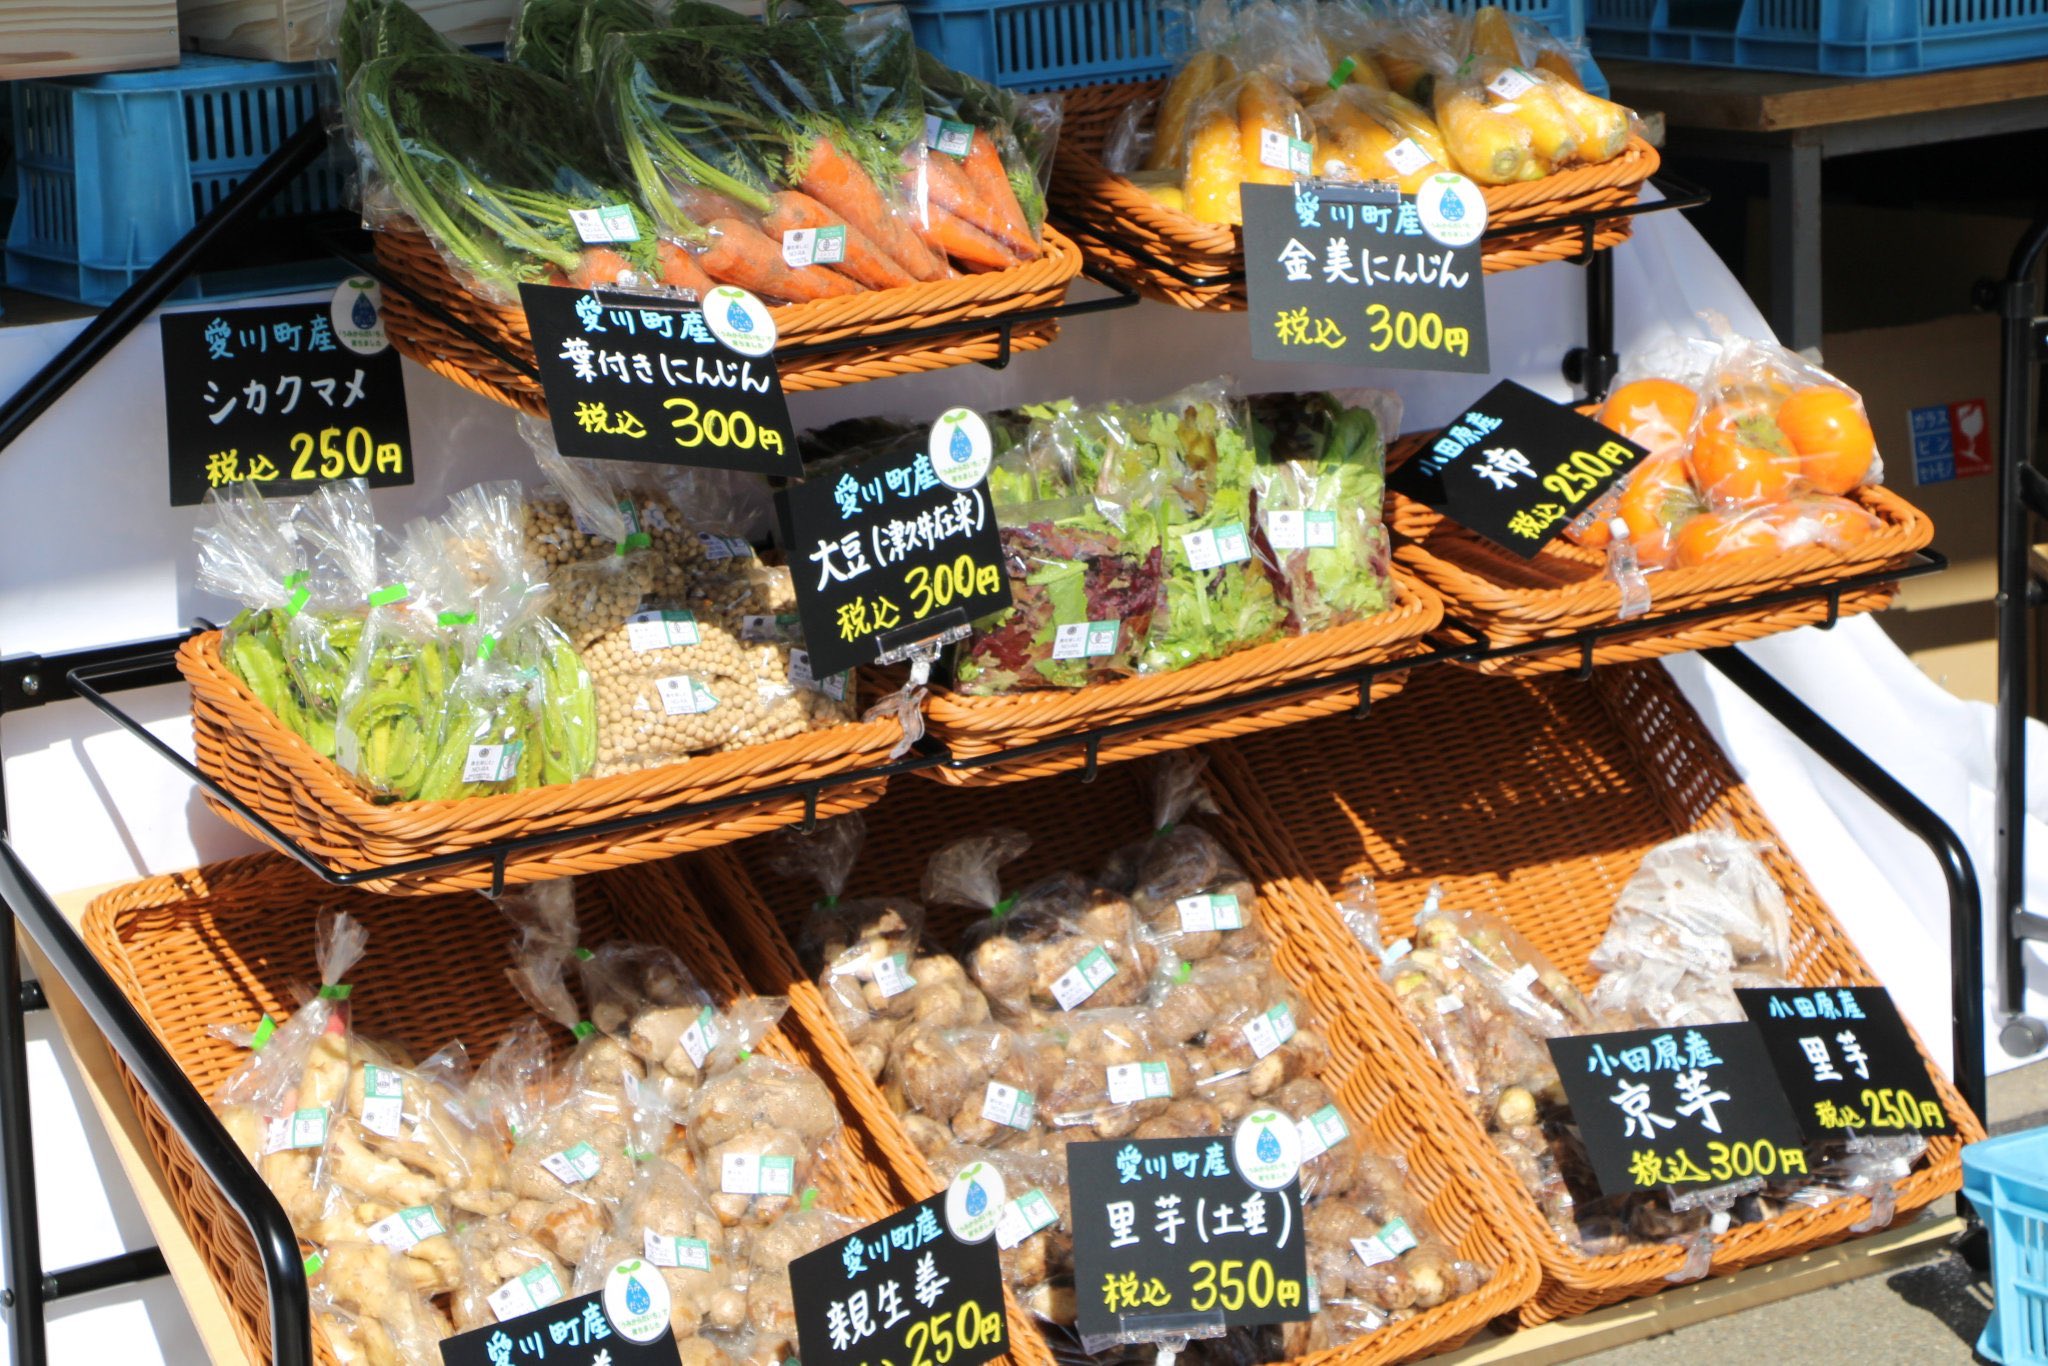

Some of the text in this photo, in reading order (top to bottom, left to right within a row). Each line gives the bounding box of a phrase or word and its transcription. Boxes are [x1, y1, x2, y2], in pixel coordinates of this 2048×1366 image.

[1295, 190, 1423, 236] 愛川町産
[1277, 236, 1470, 289] 金美にんじん
[204, 314, 337, 360] 愛川町産
[575, 294, 716, 344] 愛川町産
[1274, 303, 1469, 357] 税込 300円
[559, 337, 770, 393] 葉付きにんじん
[203, 369, 366, 425] シカクマメ
[574, 398, 784, 456] 税込 300円
[1419, 411, 1503, 478] 小田原産
[205, 426, 403, 489] 税込 250円
[1471, 447, 1538, 491] 柿
[834, 452, 942, 520] 愛川町産
[1507, 440, 1635, 540] 税込 250円
[809, 488, 985, 592] 大豆(津久井在来)
[836, 554, 1001, 643] 税込 300円
[1768, 989, 1867, 1020] 小田原産
[1587, 1029, 1724, 1078] 小田原産
[1798, 1029, 1871, 1082] 里芋
[1609, 1069, 1731, 1140] 京芋
[1814, 1089, 1946, 1130] 税込 250円
[1116, 1141, 1230, 1184] 愛川町産
[1628, 1138, 1809, 1187] 税込 300円
[841, 1205, 944, 1279] 愛川町産
[826, 1251, 951, 1351] 親生姜
[1101, 1258, 1300, 1313] 税込 350円
[486, 1301, 611, 1366] 愛川町産
[905, 1299, 1001, 1366] 250円
